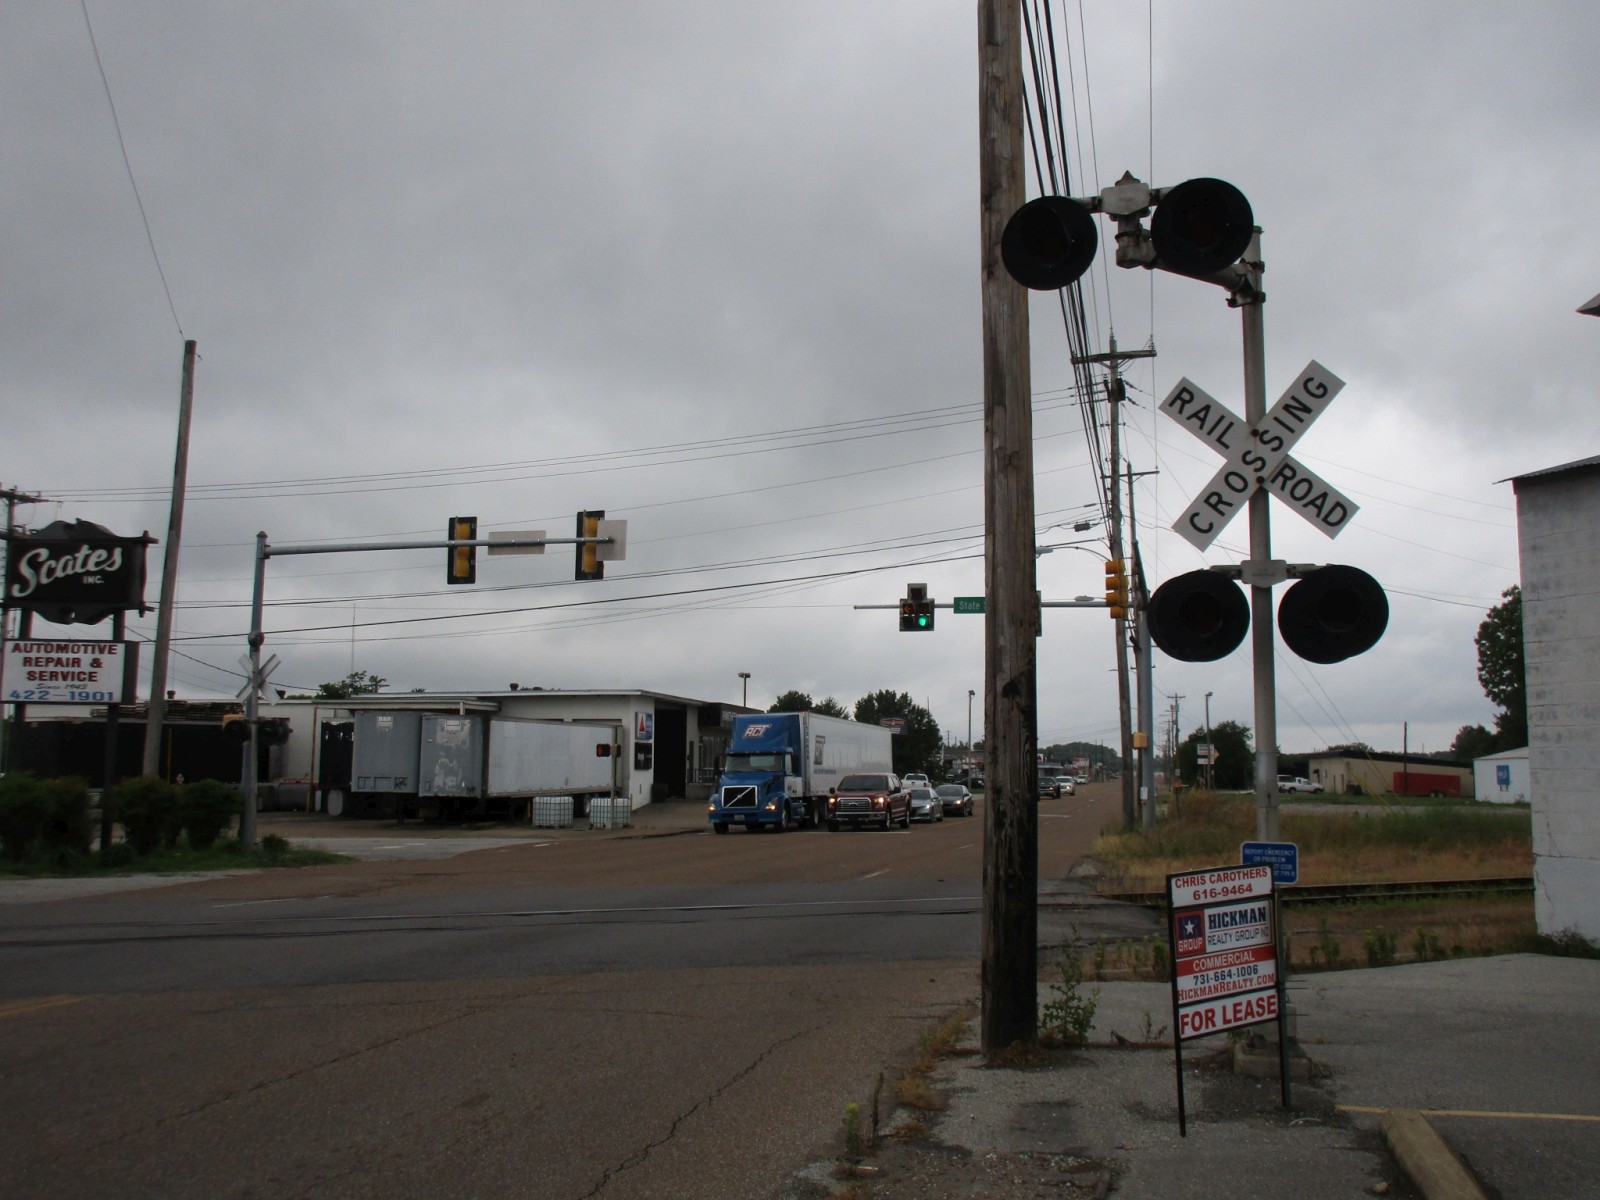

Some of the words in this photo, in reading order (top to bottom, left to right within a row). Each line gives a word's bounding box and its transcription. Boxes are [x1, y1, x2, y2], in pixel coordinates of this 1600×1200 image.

[1168, 386, 1234, 450] RAIL
[1270, 462, 1348, 528] ROAD
[1189, 376, 1328, 534] CROSSING
[12, 544, 123, 598] Scates
[959, 601, 980, 610] State
[12, 642, 118, 655] AUTOMOTIVE
[23, 657, 81, 668] REPAIR
[90, 657, 103, 669] &
[27, 671, 98, 682] SERVICE
[10, 690, 114, 701] 422-1901
[1174, 873, 1207, 889] CHRIS
[1209, 867, 1268, 885] CAROTHERS
[1192, 883, 1253, 901] 616-9464
[1208, 906, 1267, 930] HICKMAN
[1178, 937, 1203, 952] GROUP
[1207, 931, 1233, 946] REALTY
[1234, 928, 1259, 942] GROUP
[1193, 950, 1256, 972] COMMERCIAL
[1193, 964, 1259, 986] 731-664-1006
[1180, 1007, 1217, 1035] FOR
[1222, 994, 1278, 1026] LEASE
